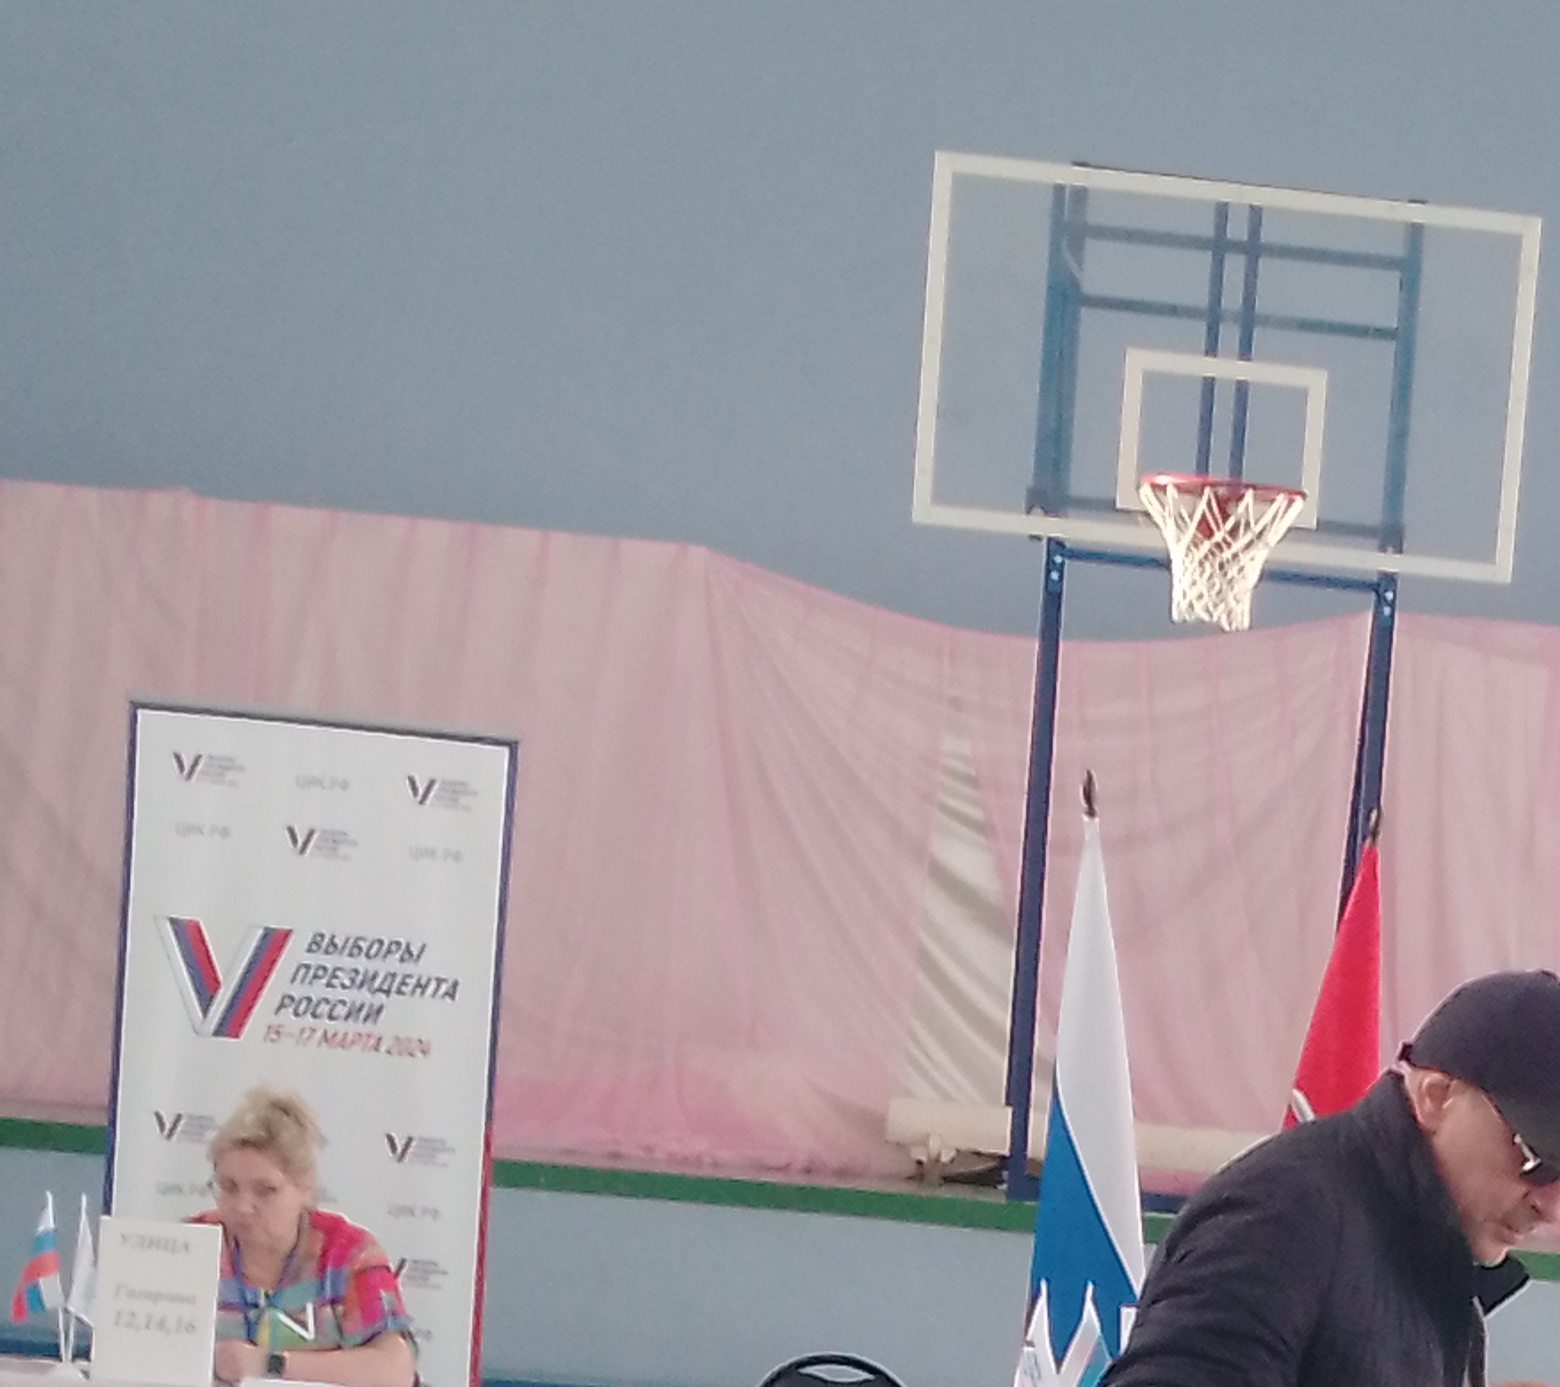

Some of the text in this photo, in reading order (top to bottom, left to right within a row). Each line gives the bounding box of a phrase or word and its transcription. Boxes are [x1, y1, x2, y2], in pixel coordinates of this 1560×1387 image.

[305, 931, 426, 964] ВЫБОРЫ
[290, 961, 460, 1002] ПРЕЗИДЕНТА
[274, 993, 384, 1025] РОССИИ
[317, 1028, 382, 1052] МАРТА
[384, 1036, 432, 1058] 2024
